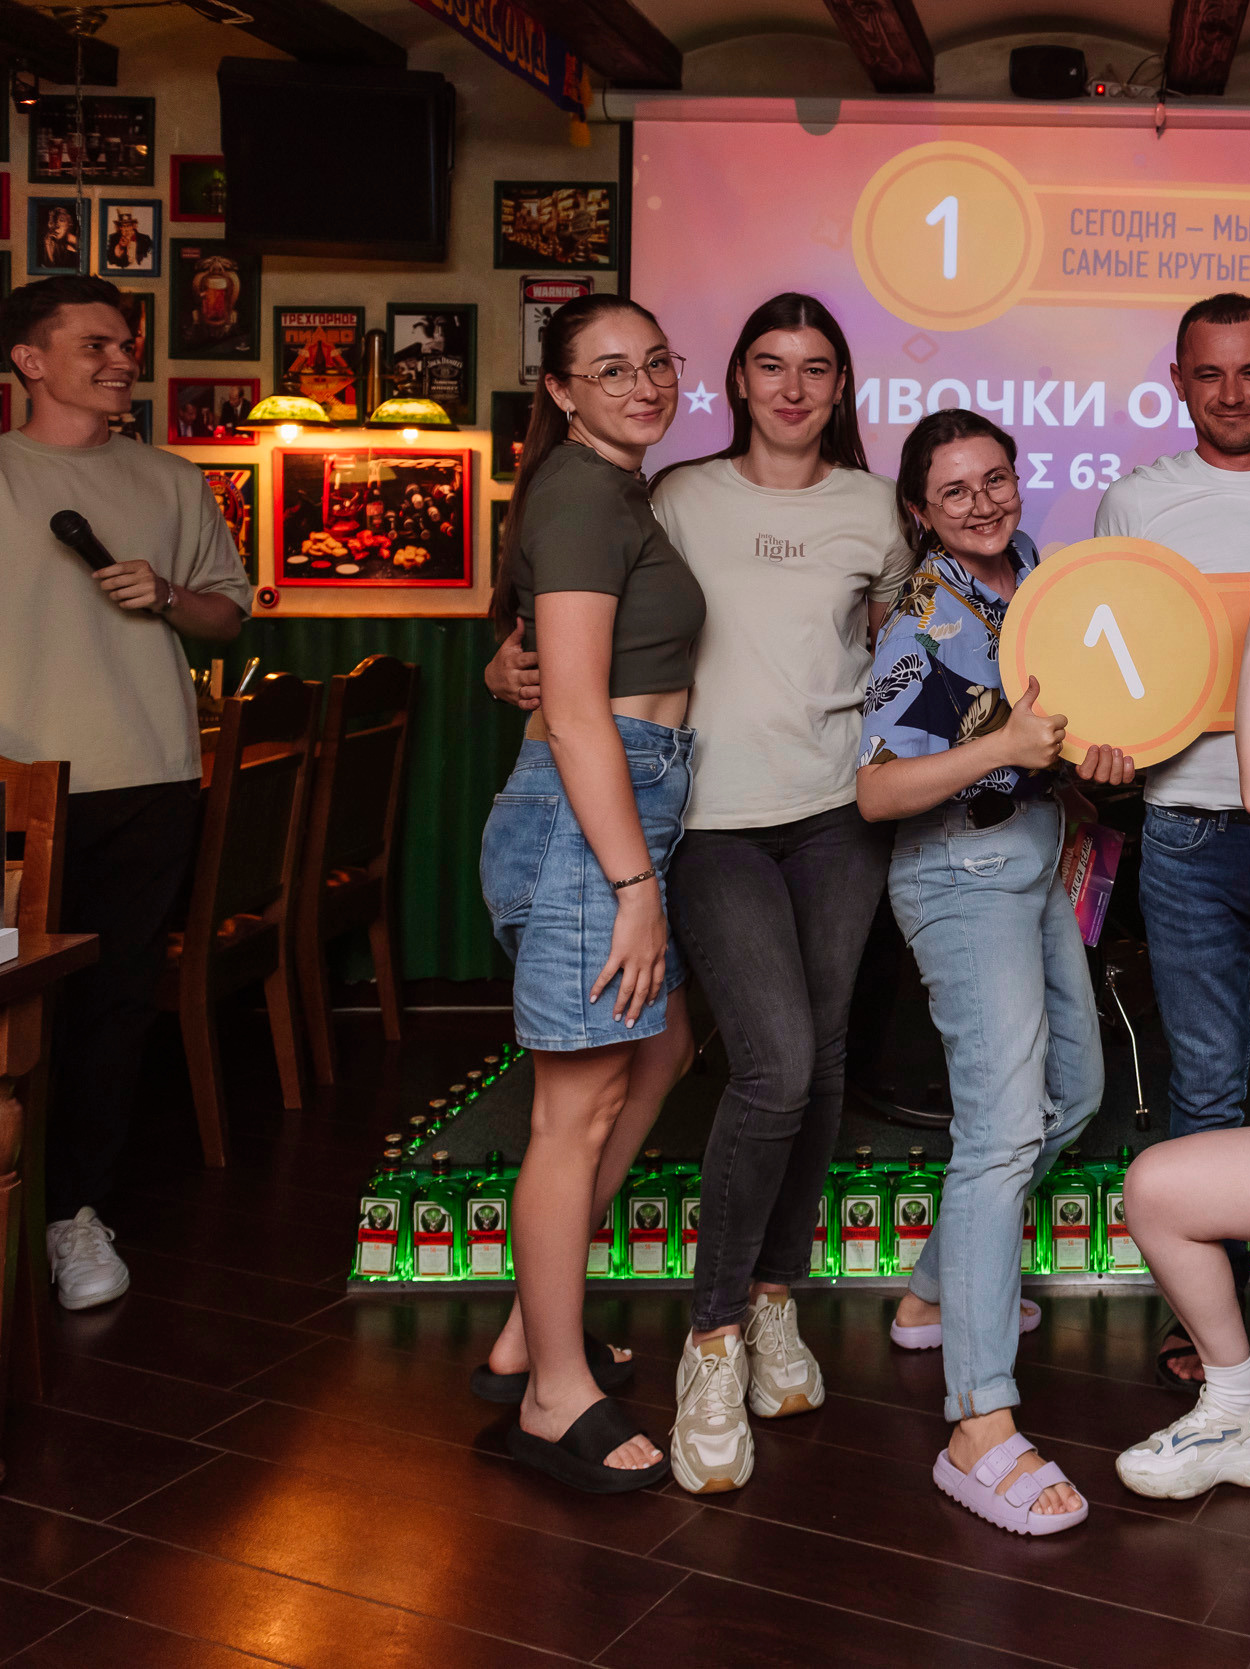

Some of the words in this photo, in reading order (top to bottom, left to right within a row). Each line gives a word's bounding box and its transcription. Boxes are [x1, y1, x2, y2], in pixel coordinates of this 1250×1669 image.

[925, 195, 958, 280] 1
[1070, 208, 1176, 243] СЕГОДНЯ
[1062, 248, 1149, 278] САМЫЕ
[533, 286, 580, 298] WARNING
[282, 313, 357, 326] ТРЕХГОРНОЕ
[855, 378, 1102, 428] ИВОЧКИ
[1069, 452, 1121, 490] 63
[755, 538, 806, 562] light
[769, 537, 784, 546] the
[1083, 603, 1146, 700] 1
